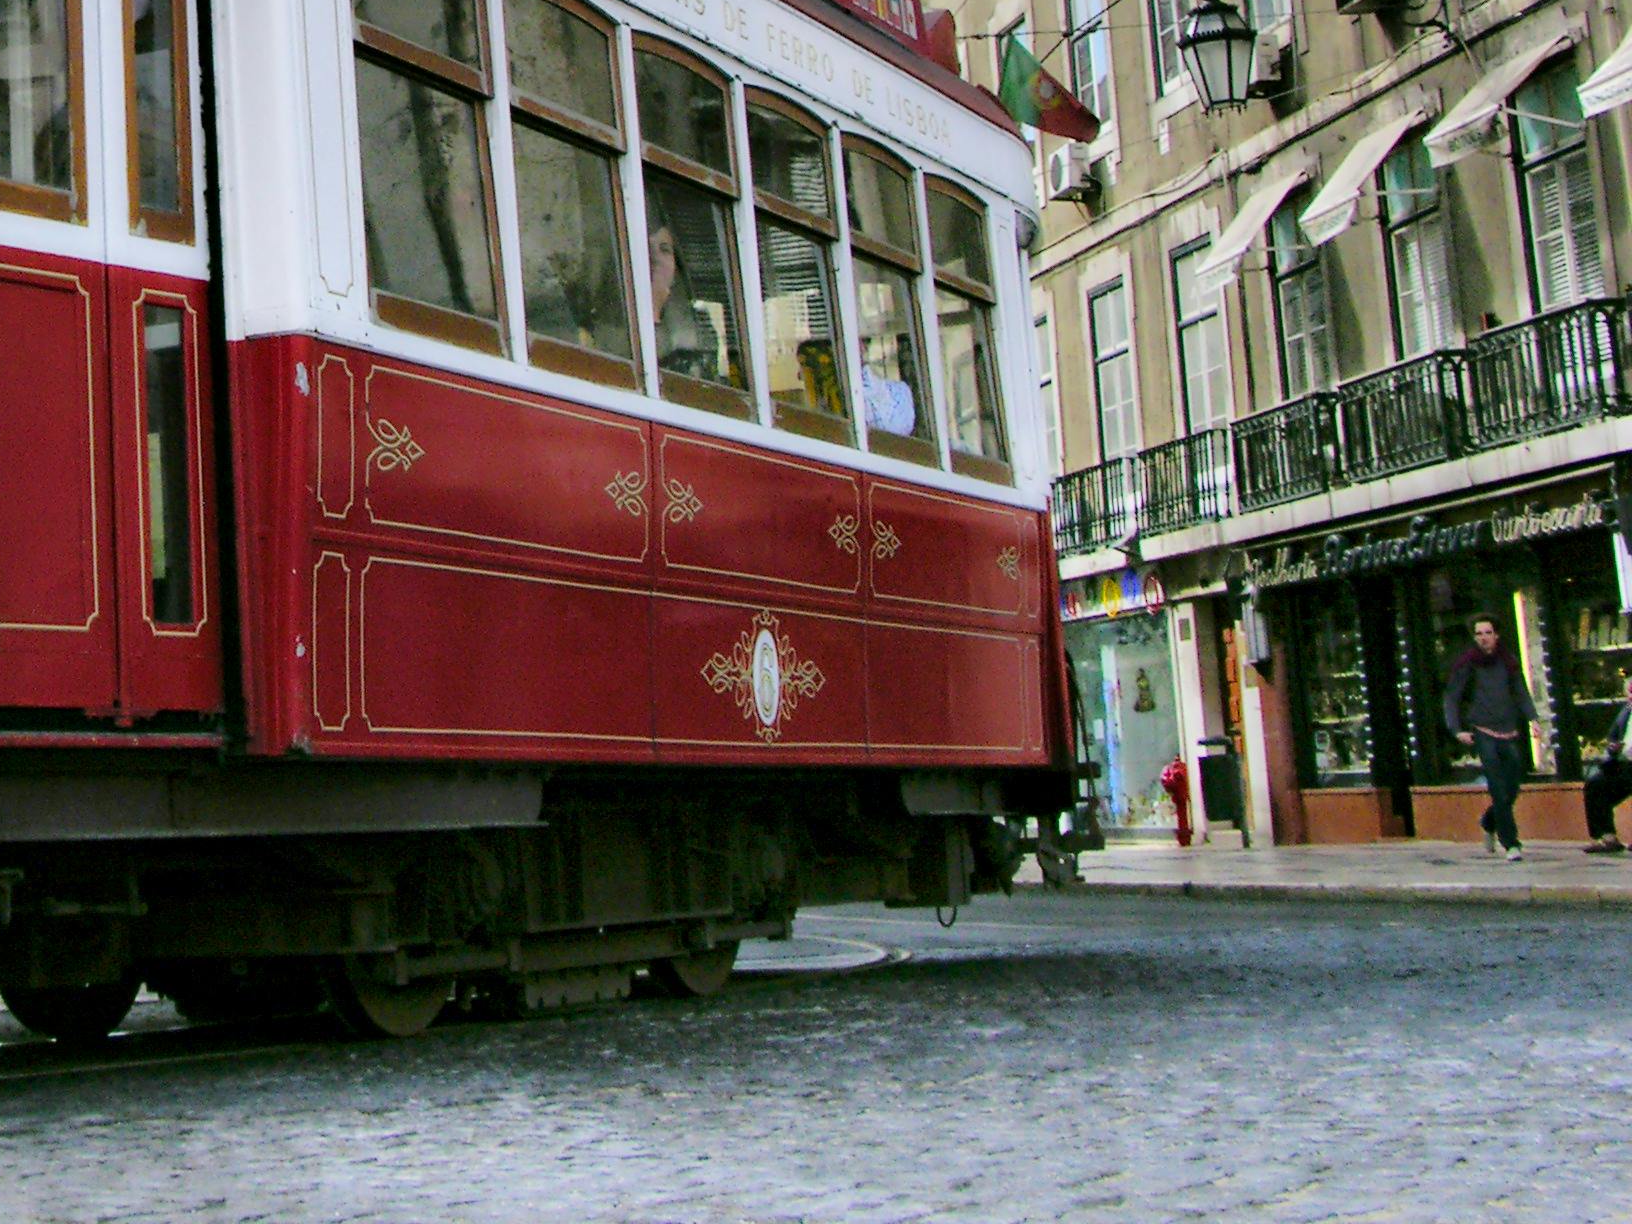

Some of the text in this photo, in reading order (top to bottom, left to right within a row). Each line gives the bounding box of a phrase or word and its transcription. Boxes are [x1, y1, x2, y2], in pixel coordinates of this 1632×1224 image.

[722, 0, 750, 41] DE
[766, 23, 835, 83] FERRO
[852, 69, 875, 106] DE
[885, 85, 953, 147] LISBOA
[759, 642, 777, 719] 6
